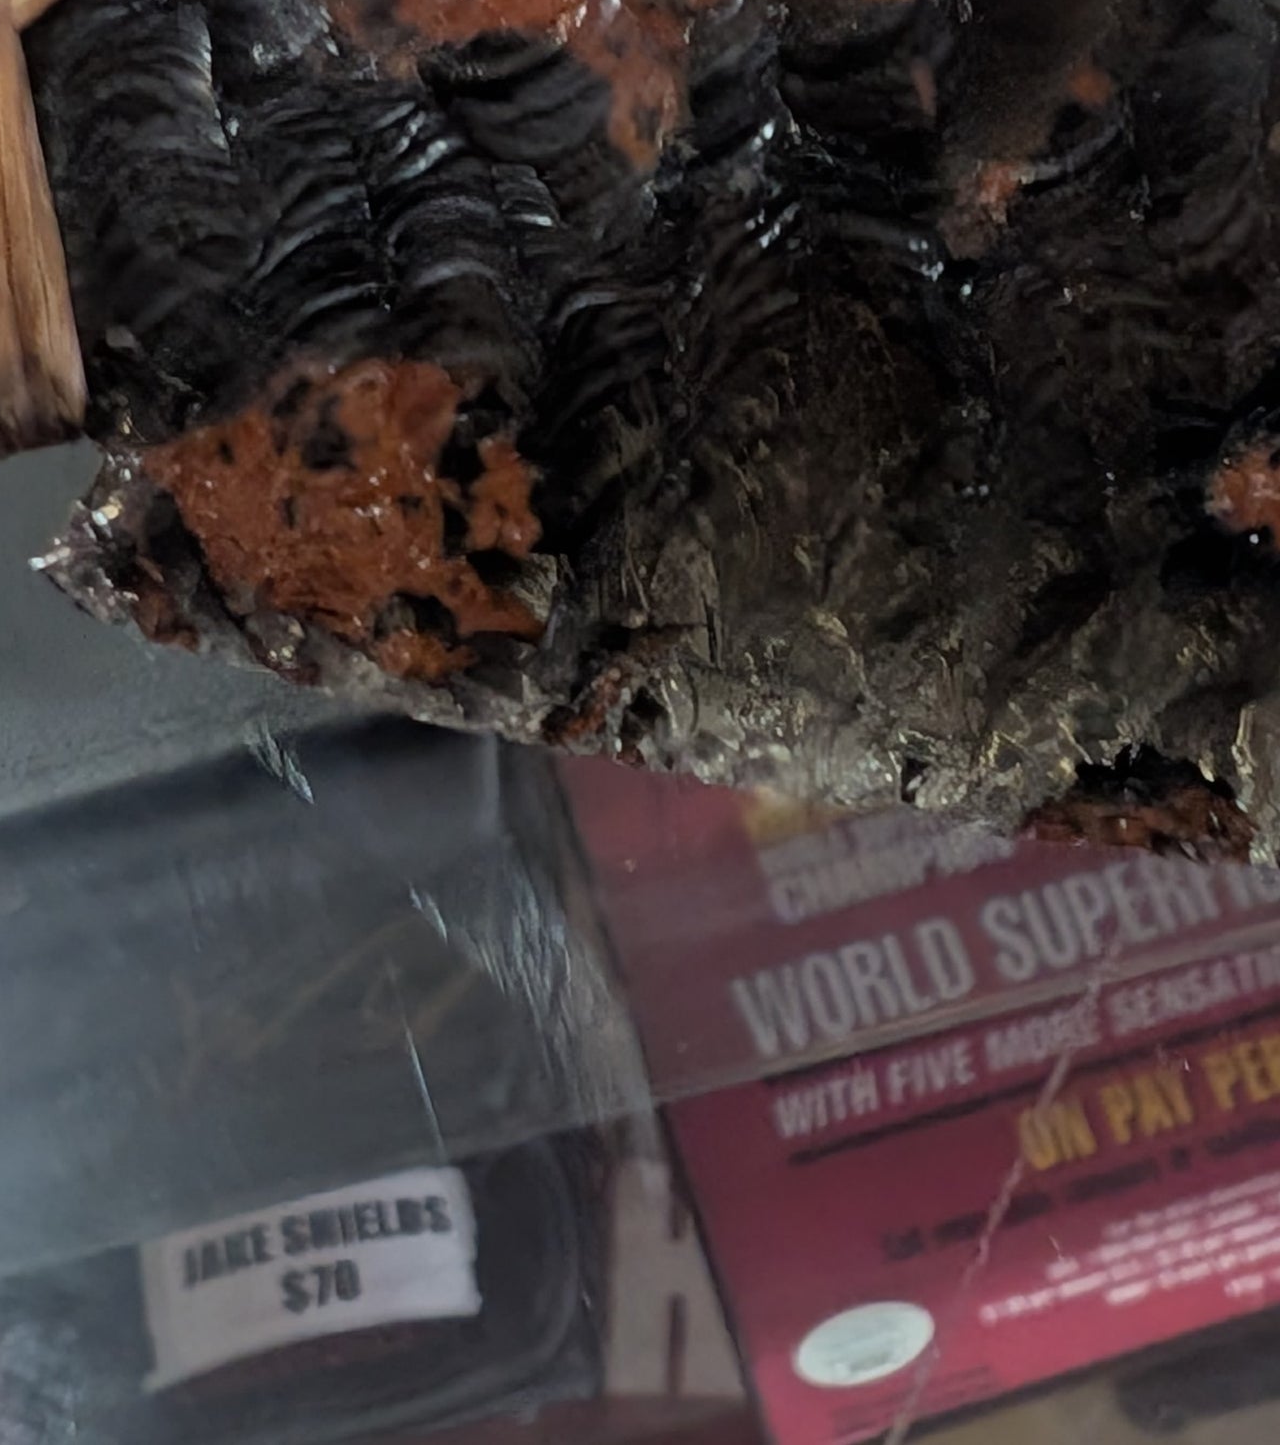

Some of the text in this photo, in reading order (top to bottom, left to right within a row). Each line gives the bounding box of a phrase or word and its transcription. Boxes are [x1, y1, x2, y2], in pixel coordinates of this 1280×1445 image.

[730, 916, 977, 1055] WORLD
[773, 1069, 881, 1139] WITH
[886, 1039, 977, 1105] FIVE
[984, 1007, 1102, 1072] MORE
[1016, 1099, 1098, 1171] ON
[1100, 1067, 1194, 1145] PAY
[180, 1194, 454, 1290] JAKE SHIELDS
[281, 1258, 362, 1314] $70
